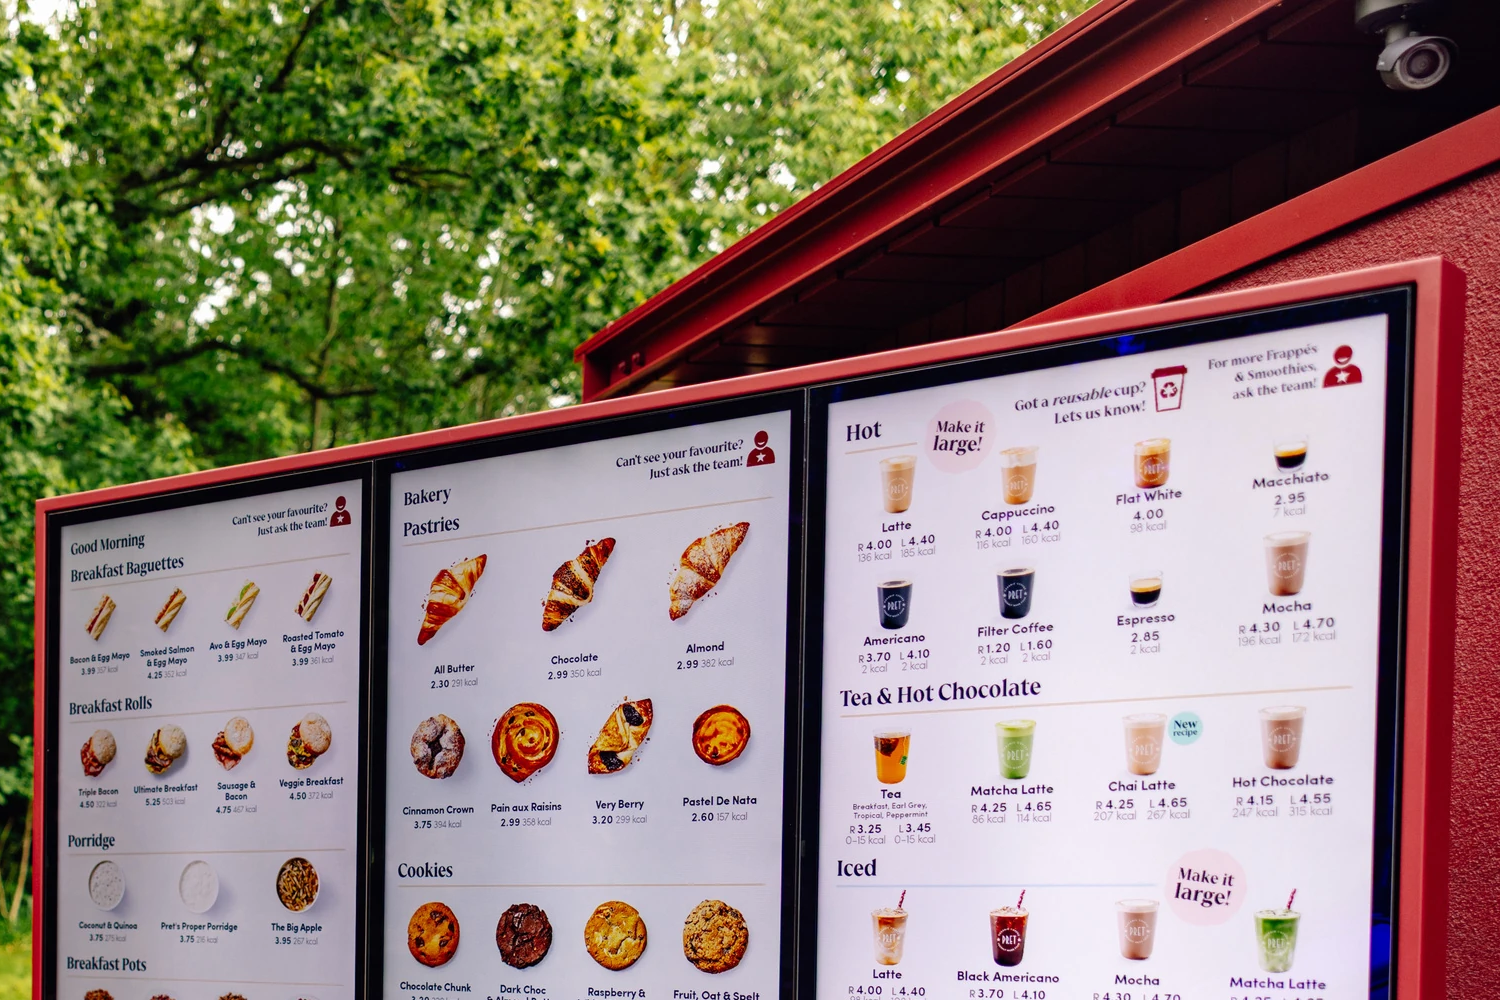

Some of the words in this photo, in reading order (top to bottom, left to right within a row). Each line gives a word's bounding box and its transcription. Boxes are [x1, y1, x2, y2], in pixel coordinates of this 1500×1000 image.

[1208, 358, 1228, 369] For
[1230, 354, 1263, 366] more
[1266, 344, 1317, 360] Frappés
[1234, 371, 1244, 382] &
[1247, 362, 1316, 379] Smoothies,
[1014, 397, 1038, 411] Got
[1041, 398, 1048, 407] a
[1052, 386, 1112, 406] reusable
[1113, 381, 1146, 397] cup?
[1232, 386, 1253, 399] ask
[1257, 384, 1277, 396] the
[1281, 378, 1316, 392] team!
[1054, 411, 1082, 424] Lets
[1085, 410, 1100, 419] us
[1104, 400, 1145, 417] know!
[846, 421, 881, 441] Hot
[937, 420, 971, 433] Make
[974, 420, 985, 433] it
[615, 454, 641, 467] Can't
[643, 453, 660, 463] see
[662, 449, 687, 463] your
[689, 439, 743, 457] favourite?
[933, 436, 982, 455] large!
[649, 467, 670, 479] Just
[672, 463, 690, 475] ask
[692, 461, 710, 472] the
[712, 455, 742, 470] team!
[1252, 471, 1329, 489] Macchiato
[404, 488, 451, 506] Bakery
[231, 514, 251, 525] Can't
[252, 514, 265, 522] see
[267, 510, 286, 522] your
[287, 502, 328, 517] favourite?
[981, 504, 1054, 521] Cappuccino
[257, 525, 273, 536] Just
[274, 522, 288, 533] ask
[289, 521, 303, 531] the
[304, 517, 327, 529] team!
[403, 516, 459, 537] Pastries
[975, 529, 981, 539] R
[983, 525, 1012, 537] 4.00
[1022, 524, 1028, 533] L
[1030, 519, 1060, 532] 4.40
[70, 539, 97, 555] Good
[100, 533, 145, 550] Morning
[70, 563, 124, 582] Breakfast
[126, 556, 184, 576] Baguettes
[887, 600, 902, 611] PRET
[282, 631, 313, 642] Roasted
[314, 629, 344, 639] Tomato
[209, 642, 223, 650] Avo
[224, 640, 230, 648] &
[231, 639, 245, 649] Egg
[246, 637, 267, 647] Mayo
[290, 644, 296, 653] &
[297, 643, 312, 654] Egg
[313, 642, 336, 651] Mayo
[685, 640, 724, 653] Almond
[217, 653, 233, 662] 3.99
[292, 657, 308, 666] 3.99
[550, 653, 598, 665] Chocolate
[676, 659, 698, 670] 2.99
[701, 658, 716, 668] 382
[718, 656, 734, 666] kcal
[547, 669, 568, 680] 2.99
[570, 668, 585, 678] 350
[586, 667, 601, 677] kcal
[839, 689, 872, 706] Tea
[876, 687, 892, 704] &
[897, 685, 934, 703] Hot
[938, 678, 1041, 701] Chocolate
[69, 698, 122, 715] Breakfast
[124, 695, 152, 711] Rolls
[1174, 720, 1196, 728] New
[1172, 728, 1198, 737] recipe
[279, 777, 304, 789] Veggie
[306, 776, 343, 786] Breakfast
[1232, 777, 1257, 787] Hot
[1260, 774, 1333, 787] Chocolate
[289, 791, 306, 800] 4.50
[682, 795, 713, 806] Pastel
[716, 795, 730, 805] De
[732, 795, 757, 805] Nata
[852, 802, 889, 810] Breakfast,
[907, 801, 927, 809] Grey,
[691, 812, 714, 822] 2.60
[716, 812, 729, 821] 157
[731, 811, 747, 821] kcal
[68, 833, 115, 850] Porridge
[397, 861, 453, 878] Cookies
[837, 858, 876, 877] Iced
[271, 922, 285, 931] The
[286, 922, 298, 933] Big
[299, 922, 322, 933] Apple
[274, 936, 291, 945] 3.95
[66, 955, 119, 970] Breakfast
[122, 957, 146, 971] Pots
[957, 970, 989, 981] Black
[992, 971, 1059, 983] Americano
[500, 984, 521, 994] Dark
[523, 985, 546, 994] Choc
[673, 989, 698, 1000] Fruit,
[701, 990, 721, 1000] Oat
[723, 991, 731, 1000] &
